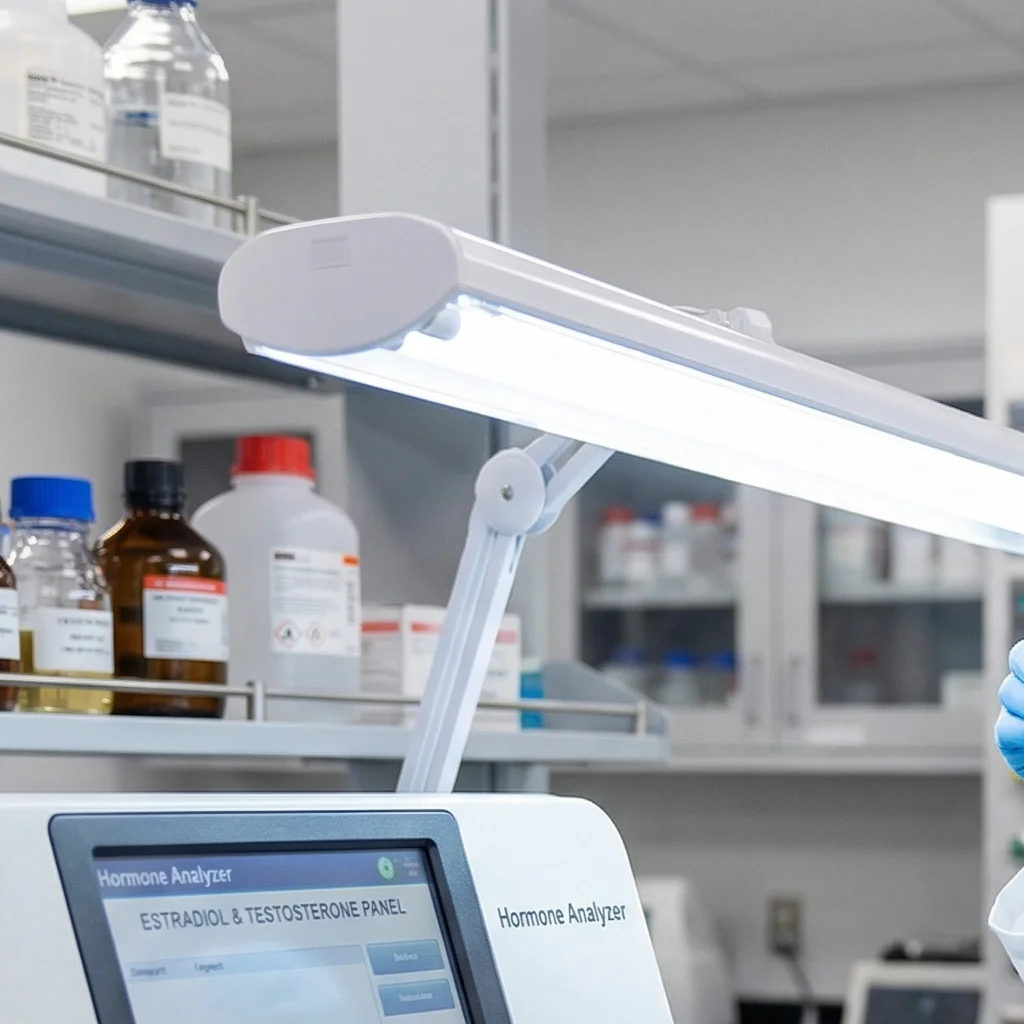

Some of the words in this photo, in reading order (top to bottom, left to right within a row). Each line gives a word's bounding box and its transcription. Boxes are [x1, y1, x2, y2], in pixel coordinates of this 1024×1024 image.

[97, 868, 168, 887] Hormone
[171, 866, 232, 888] Analyzer
[140, 908, 229, 930] ESTRADIOL
[232, 908, 244, 924] &
[245, 901, 360, 924] TESTOSTERONE
[362, 898, 407, 917] PANEL
[497, 907, 565, 928] Hormone
[568, 901, 626, 927] Analyzer
